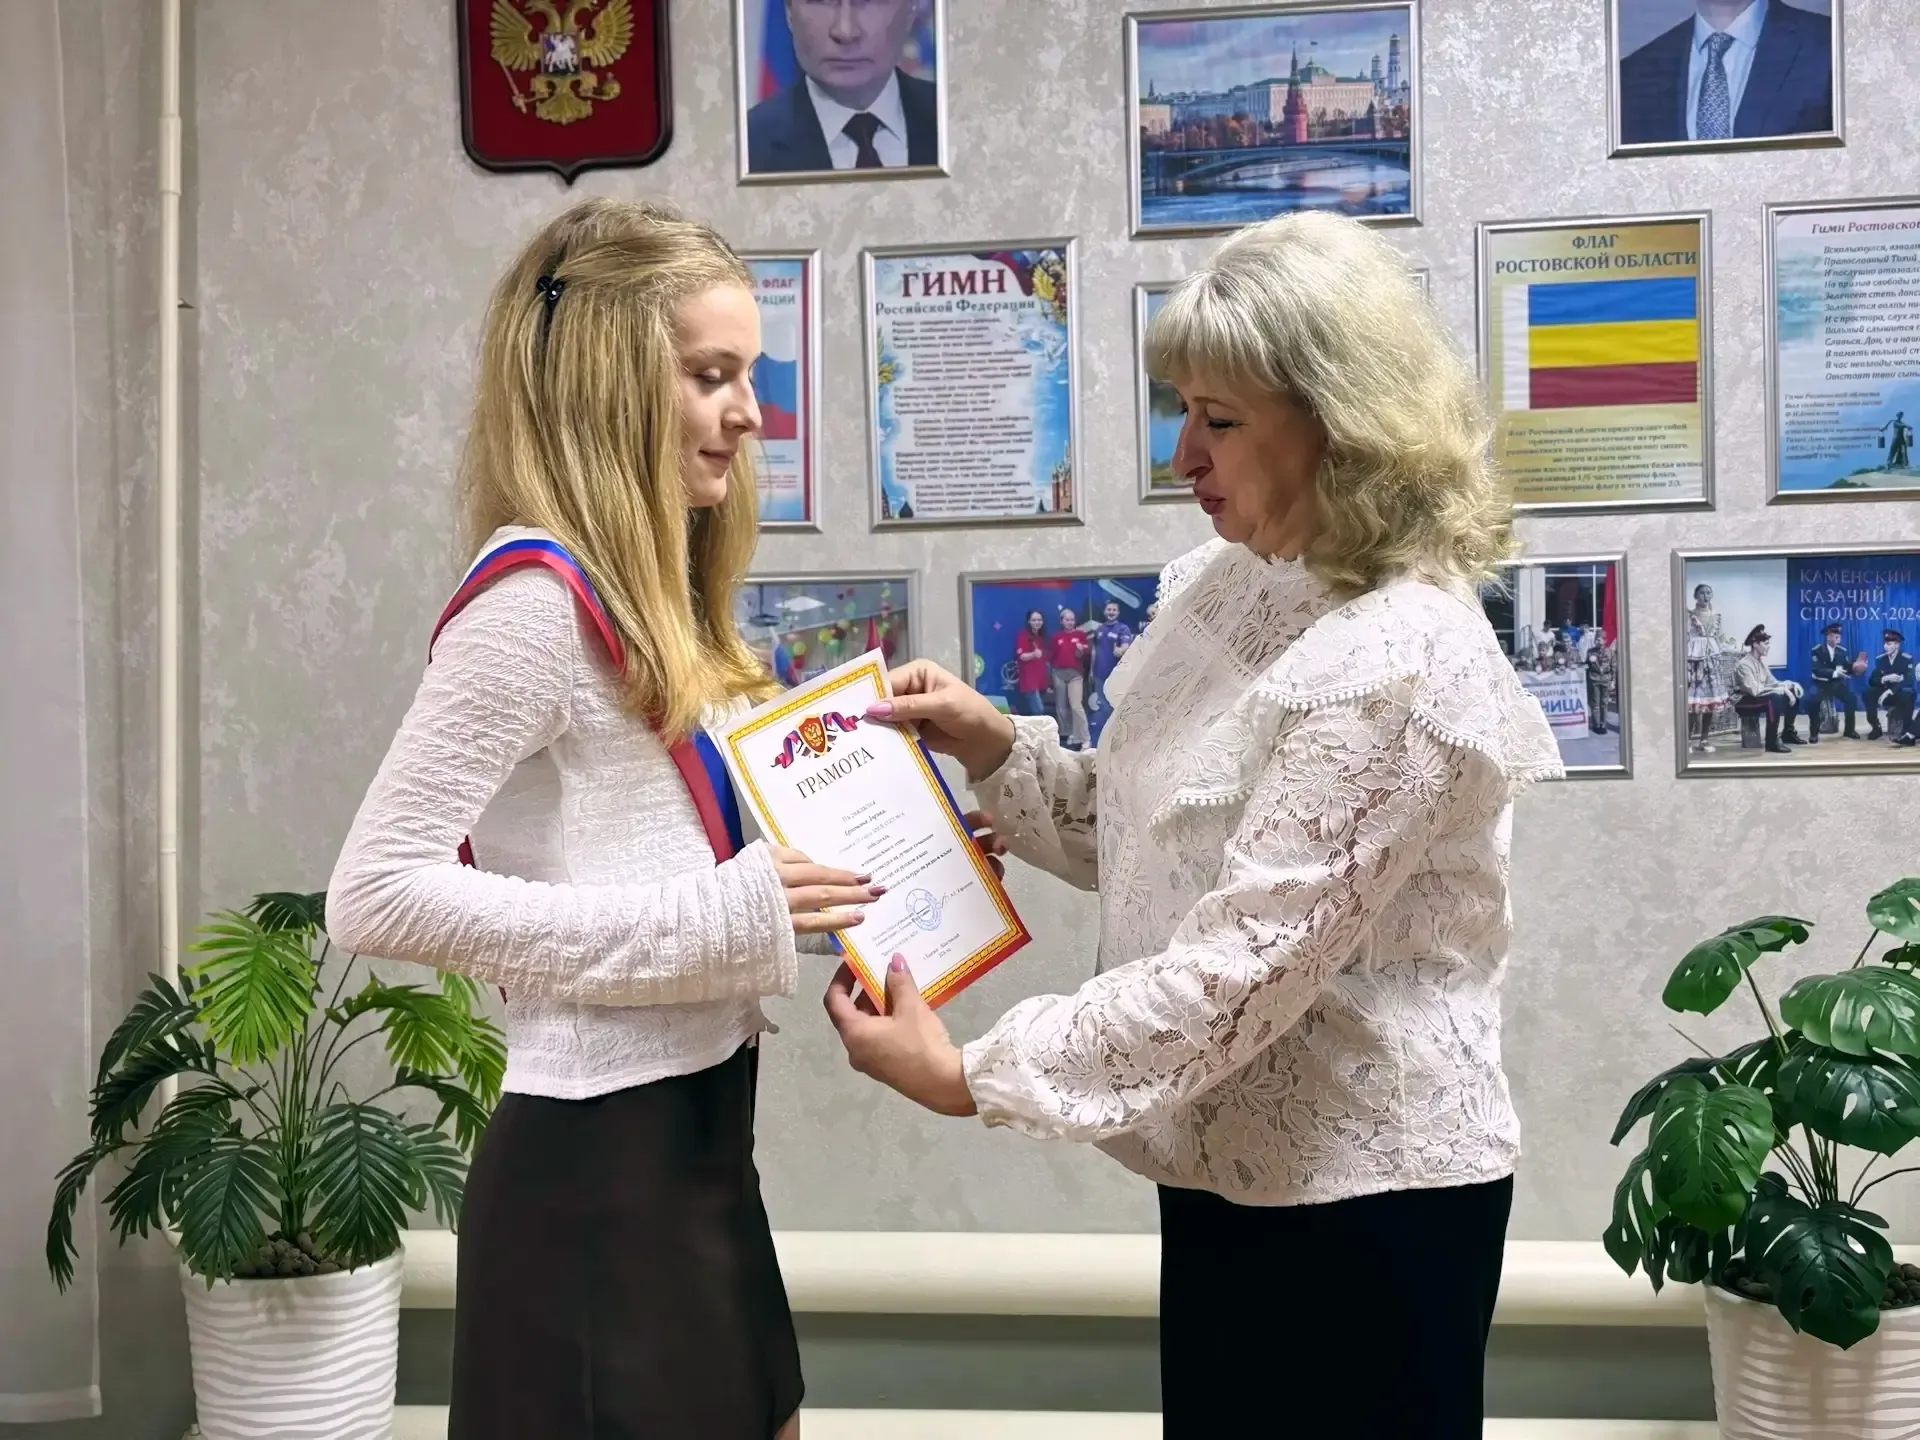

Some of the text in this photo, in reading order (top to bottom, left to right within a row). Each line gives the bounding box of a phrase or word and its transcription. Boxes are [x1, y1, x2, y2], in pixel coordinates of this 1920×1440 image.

[1811, 223, 1845, 234] Гимн
[1572, 235, 1620, 249] ФЛАГ
[1495, 251, 1697, 274] РОСТОВСКОЙ ОБЛАСТИ
[902, 269, 1007, 297] ГИМН
[876, 299, 1035, 315] Российской Федерации
[1800, 563, 1911, 584] КАМЕНСКИЙ
[1800, 585, 1884, 604] КАЗАЧИЙ
[796, 746, 875, 800] ГРАМОТА
